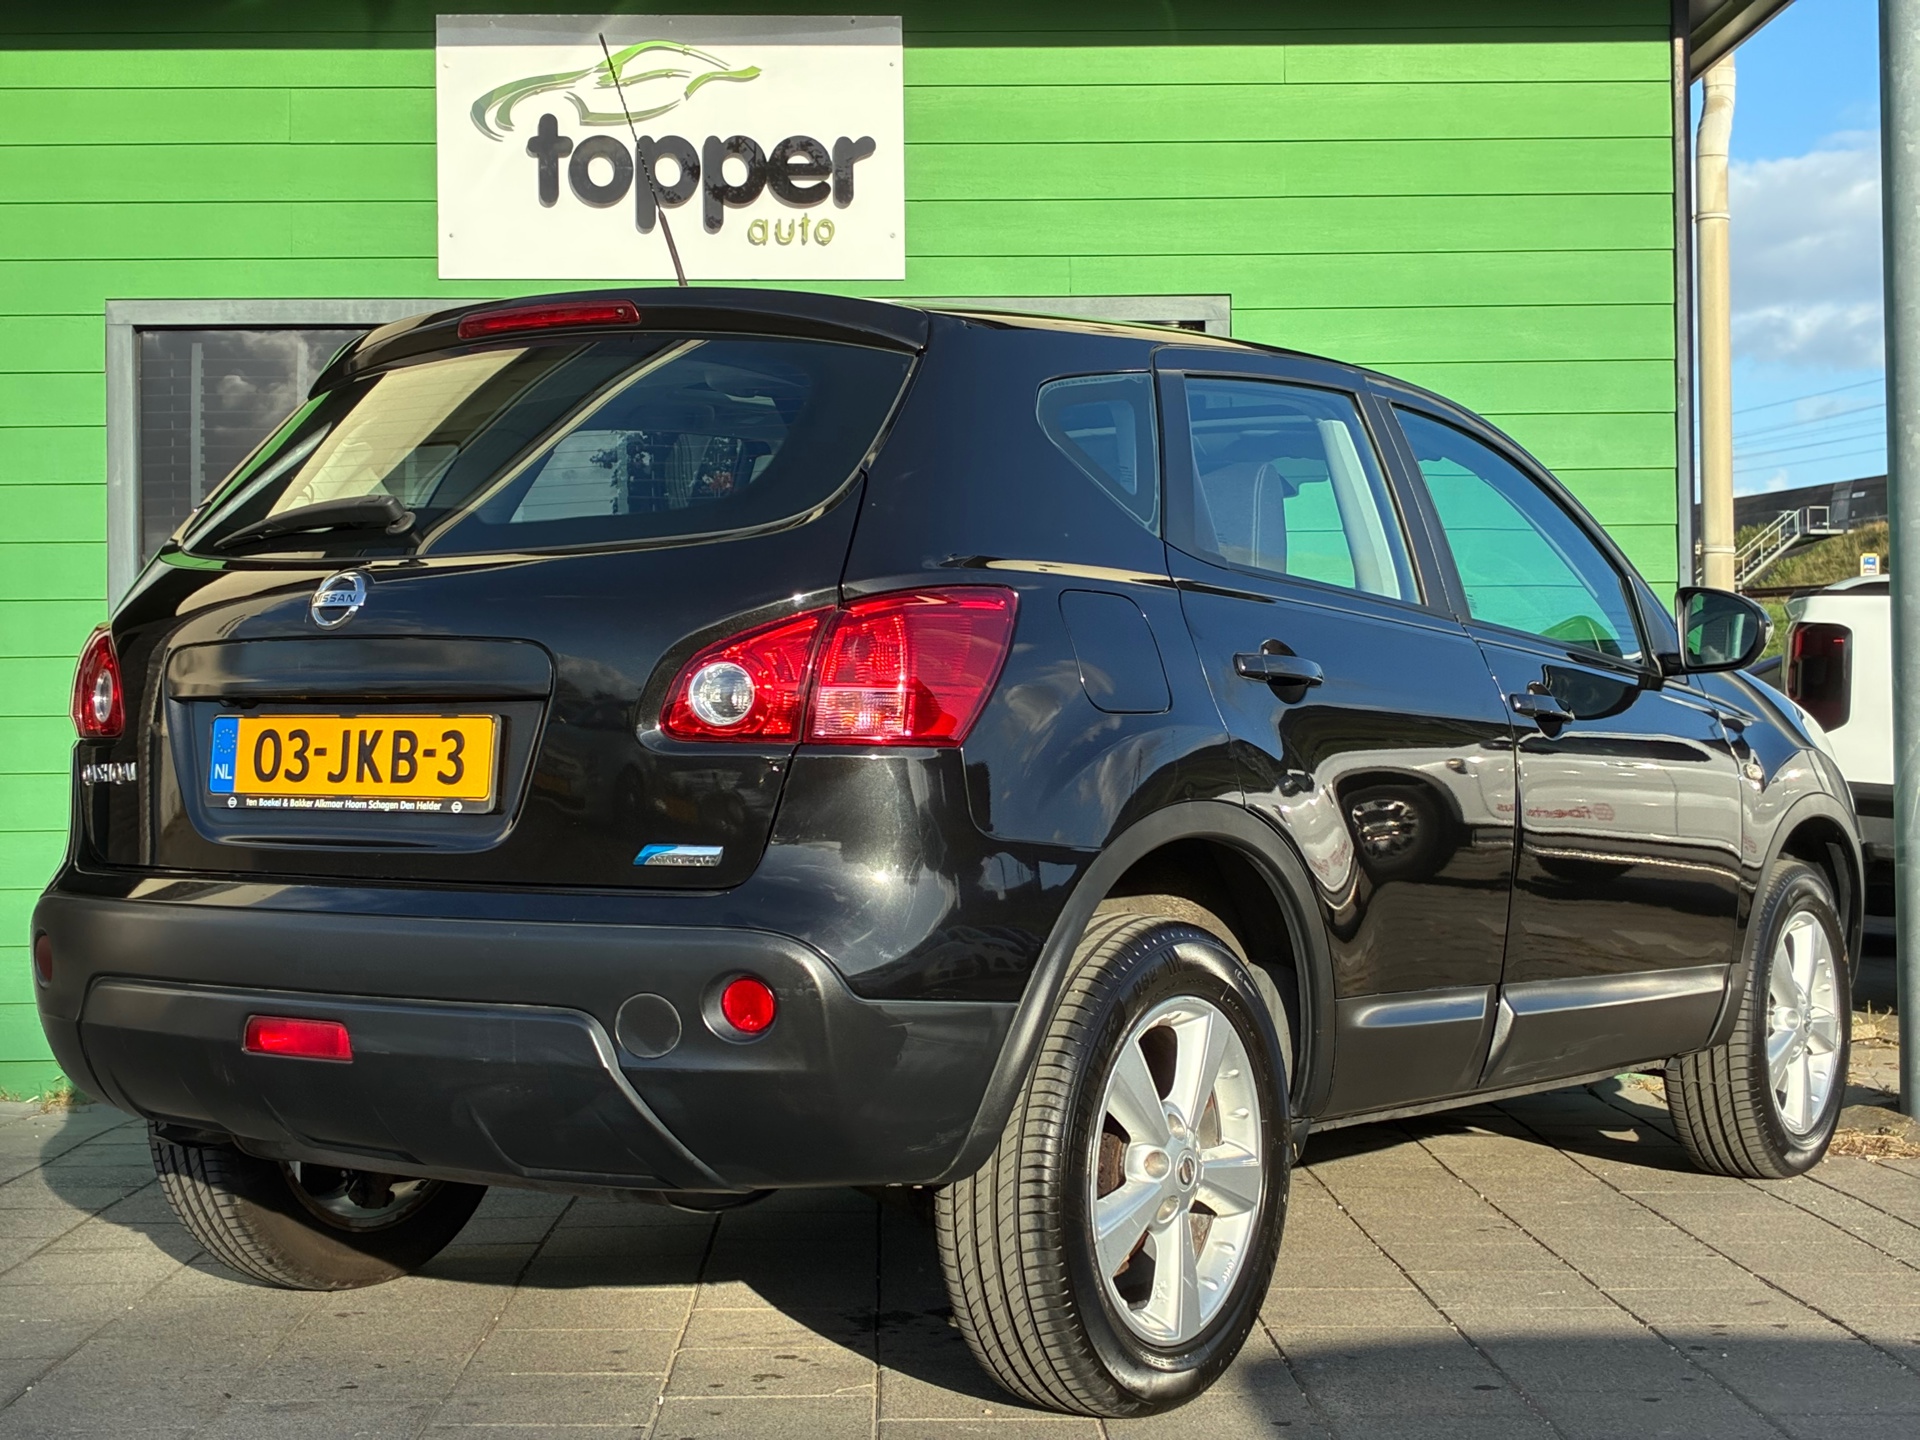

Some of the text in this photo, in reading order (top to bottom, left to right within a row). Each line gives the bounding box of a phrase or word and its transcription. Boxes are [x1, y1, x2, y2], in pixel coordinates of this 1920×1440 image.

[526, 113, 876, 234] topper
[747, 212, 836, 247] auto
[313, 593, 357, 603] NISSAN
[253, 728, 466, 786] 03-JKB-3
[214, 763, 233, 781] NL
[259, 797, 281, 807] Boekel
[283, 798, 289, 808] &
[290, 798, 314, 808] Bakker
[314, 799, 344, 809] Alkmaar
[345, 800, 367, 809] Hoorn
[368, 800, 399, 812] Schagen
[400, 801, 415, 810] Den
[416, 801, 442, 811] Helder
